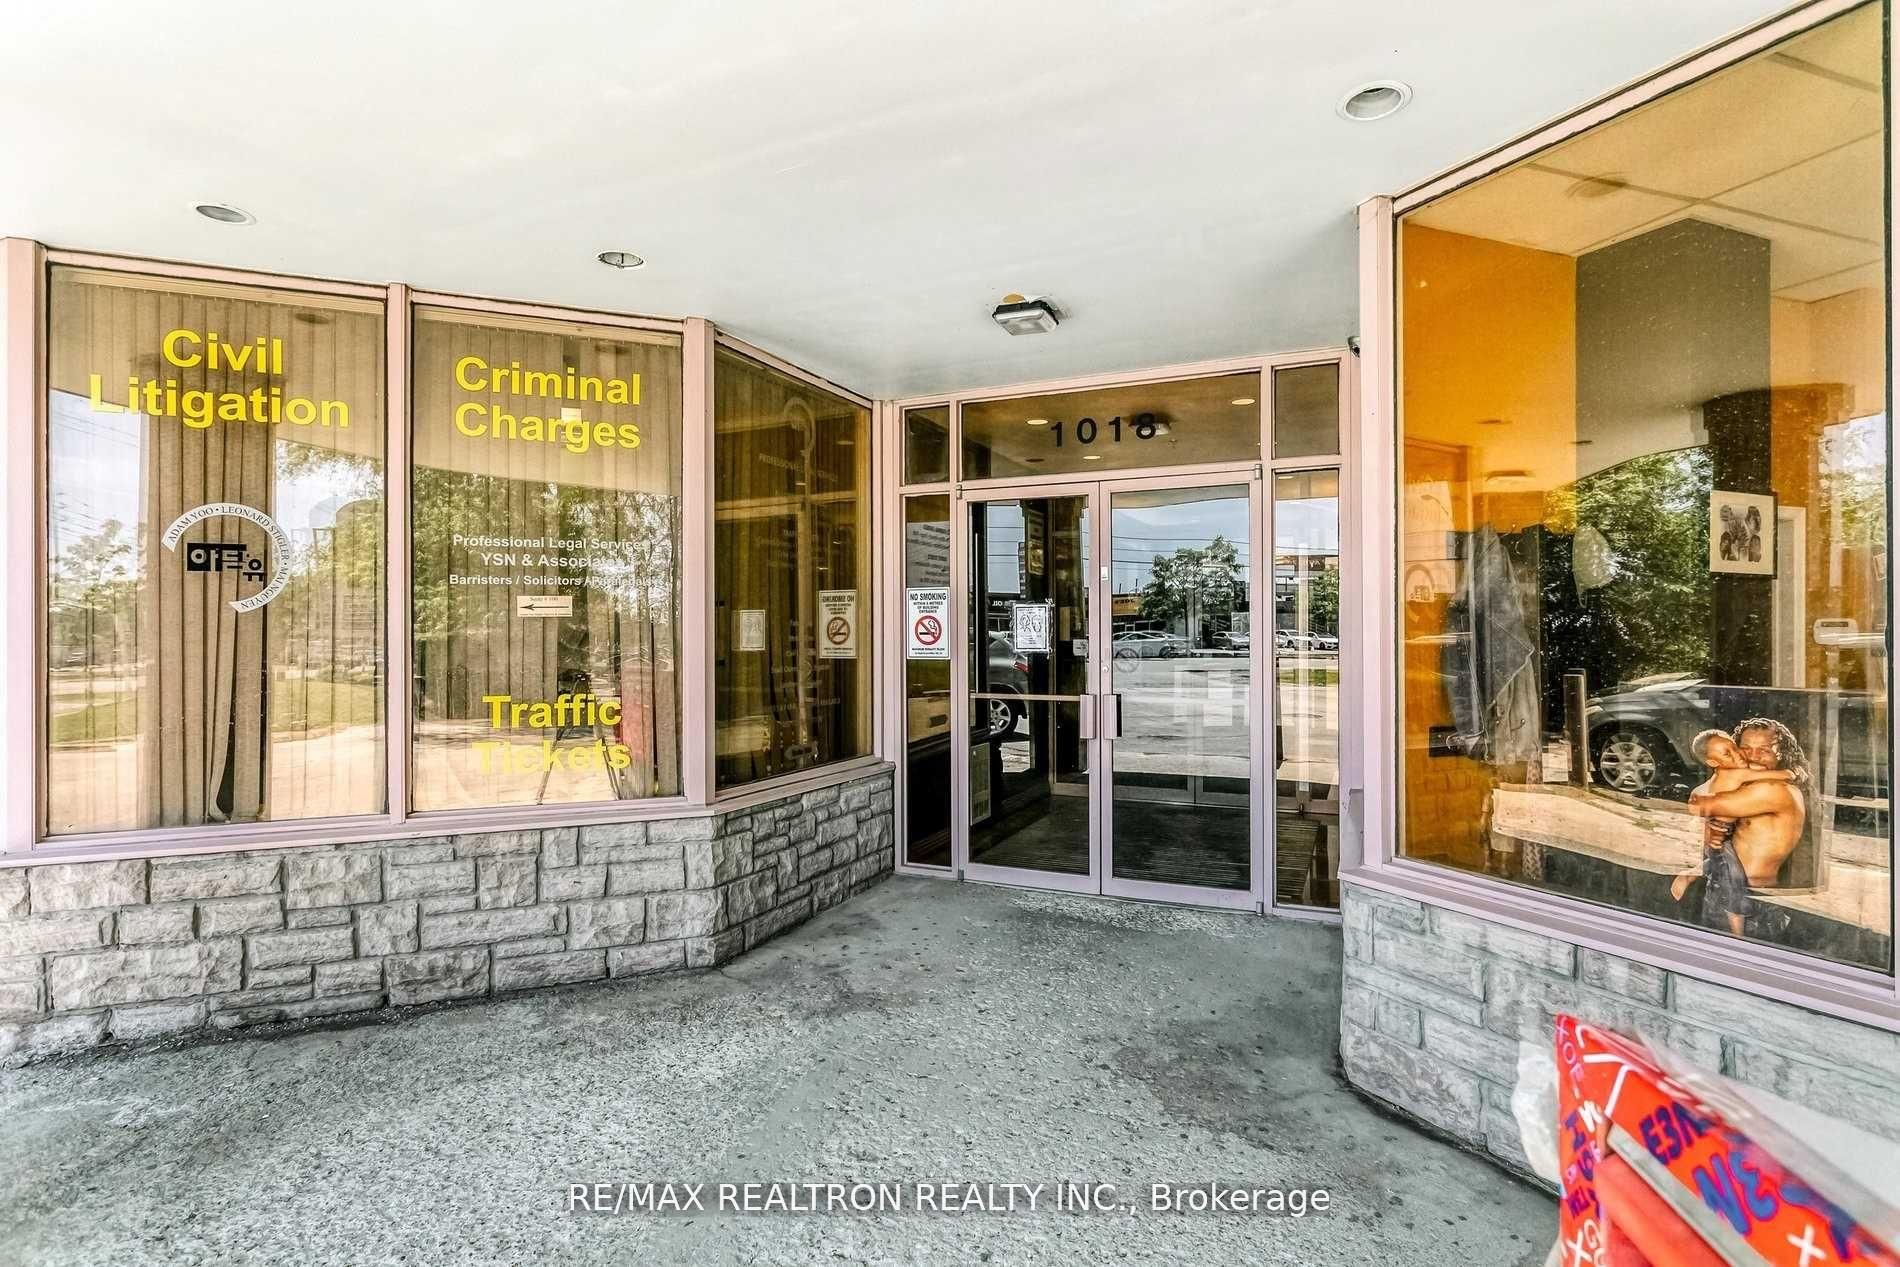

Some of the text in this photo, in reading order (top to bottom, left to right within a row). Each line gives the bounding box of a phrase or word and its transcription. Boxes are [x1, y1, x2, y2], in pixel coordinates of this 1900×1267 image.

[162, 329, 283, 375] Civil
[455, 356, 641, 405] Criminal
[89, 374, 350, 428] Litigation
[455, 402, 641, 453] Charges
[1051, 412, 1156, 447] 1018
[168, 517, 192, 543] ADAM
[191, 506, 213, 520] YOO
[221, 505, 270, 529] LEONARD
[270, 525, 290, 560] STIGLER
[453, 534, 544, 549] Professional
[549, 537, 586, 551] Legal
[480, 553, 516, 567] YSN
[521, 554, 533, 567] &
[240, 585, 280, 609] NGUYEN
[449, 575, 512, 586] Barristers
[523, 575, 581, 586] Solicitors
[482, 693, 622, 728] Traffic
[471, 739, 632, 775] Tickets
